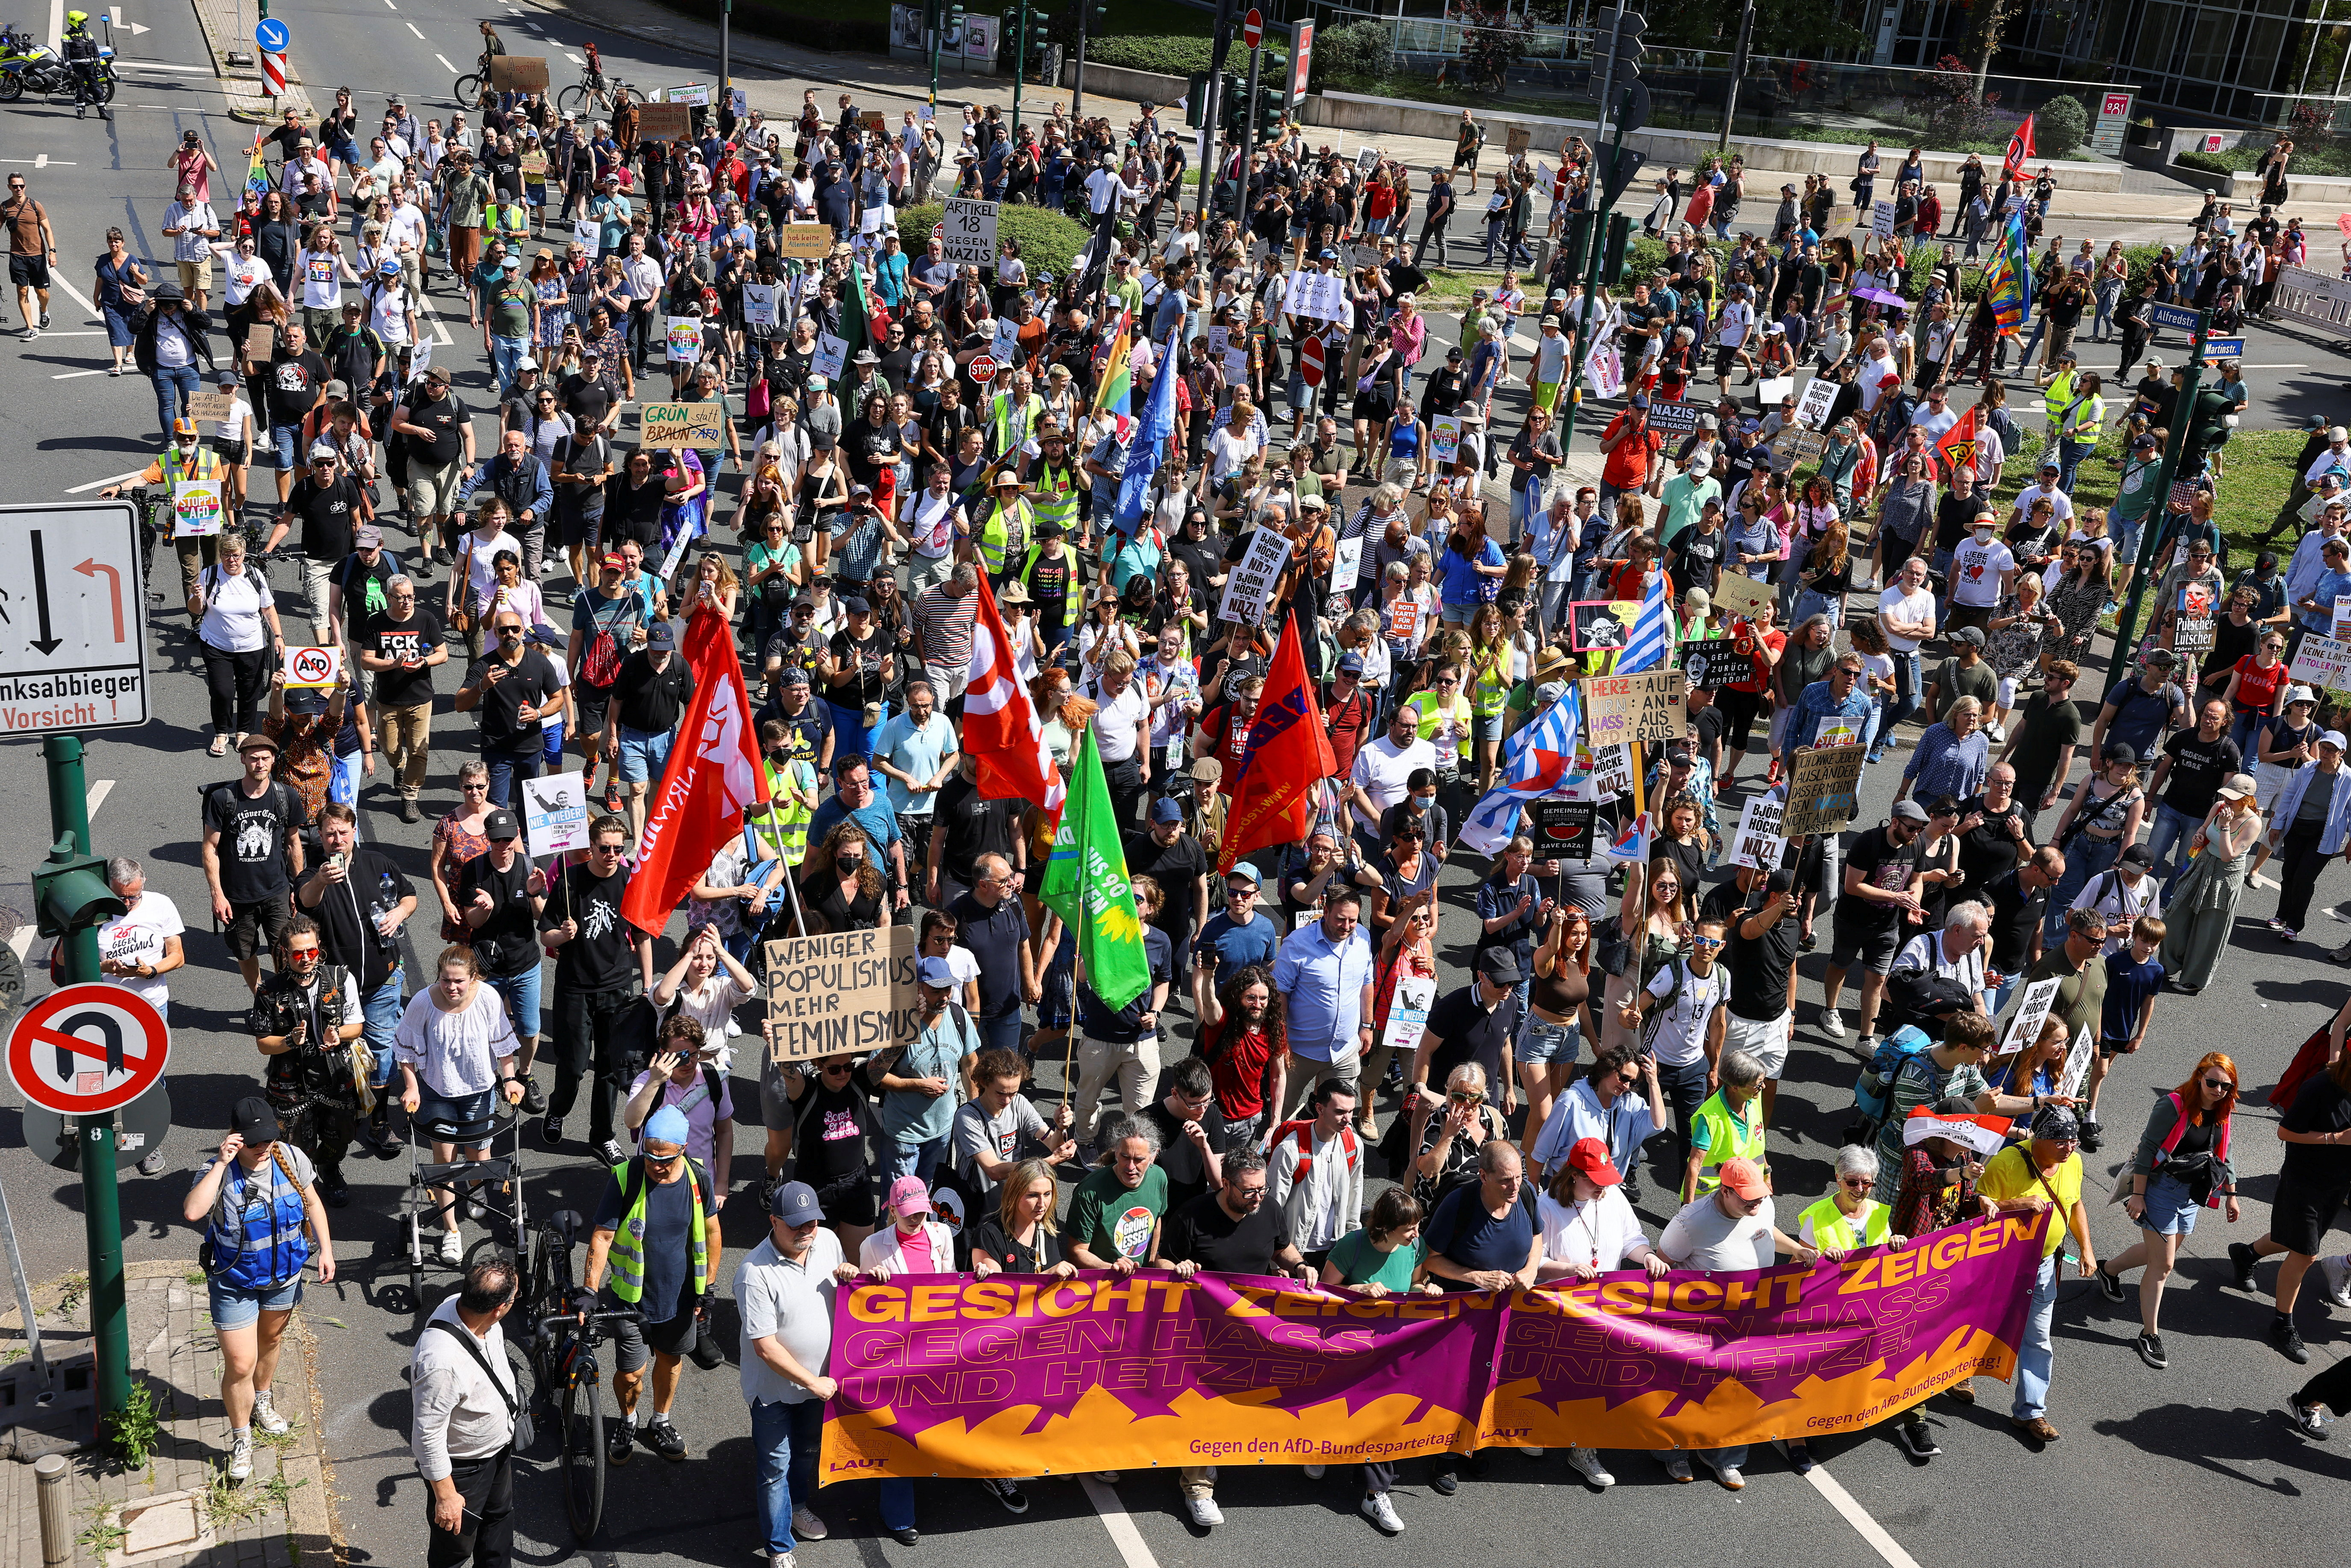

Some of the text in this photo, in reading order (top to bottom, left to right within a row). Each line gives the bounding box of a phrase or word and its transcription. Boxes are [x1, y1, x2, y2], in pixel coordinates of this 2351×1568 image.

[669, 88, 706, 96] MENSCHLICHKEIT
[642, 104, 672, 112] Schmelzt
[856, 118, 885, 132] fck AfD
[944, 200, 996, 218] ARTIKEL
[958, 216, 981, 233] 18
[788, 239, 823, 248] Alternative!
[946, 237, 988, 247] GEGEN
[943, 246, 992, 262] NAZIS
[309, 262, 333, 271] FCK
[310, 270, 333, 280] AFD
[231, 281, 253, 290] RECHTS
[1305, 277, 1327, 288] Gebe
[1294, 284, 1330, 298] Nachhilfe
[1294, 299, 1329, 314] Geschichte
[2157, 309, 2195, 327] Alfredstr.
[671, 329, 695, 338] STOPPT
[677, 338, 692, 348] AFD
[1000, 338, 1013, 348] WIEDER!
[2204, 341, 2237, 354] Martinstr.
[816, 351, 843, 365] NIE WIEDER!
[972, 364, 994, 375] STOP
[1812, 381, 1834, 394] BJÖRN
[1808, 389, 1830, 403] HÖCKE
[645, 404, 718, 424] GRÜN statt
[1651, 403, 1695, 419] NAZIS
[1667, 422, 1692, 431] KACKE
[1734, 458, 1753, 470] PUMA
[180, 495, 215, 507] STOPPT
[189, 506, 209, 519] AFD
[1260, 532, 1285, 551] BJÖRN
[1255, 546, 1280, 563] HÖCKE
[1963, 556, 1987, 565] GEGEN
[1965, 550, 1989, 561] LIEBE
[1342, 560, 1359, 572] WIEDER!
[1235, 572, 1264, 587] BJÖRN
[1232, 583, 1261, 598] HÖCKE
[1227, 598, 1257, 615] NAZI
[1394, 622, 1412, 631] NAZIS
[2176, 616, 2216, 632] Putscher-
[380, 635, 419, 649] FCK
[2174, 631, 2213, 646] Lutscher
[2304, 636, 2341, 651] DIE AFD
[1689, 641, 1721, 651] HÖCKE
[298, 658, 327, 671] AfD
[1711, 663, 1749, 674] ZURÜCK
[2297, 656, 2347, 673] INTOLERANT
[1591, 675, 1681, 697] HERZ AUF
[1709, 674, 1750, 685] MORDOR!
[1591, 694, 1665, 716] HIRN AN
[1590, 710, 1669, 732] HASS AUS
[1590, 727, 1675, 748] AFD RAUS
[1594, 755, 1623, 773] HÖCKE
[2181, 759, 2202, 770] LIBRE
[1790, 793, 1853, 814] DEN NAZIS
[529, 809, 586, 830] NIE WIEDER!
[1741, 837, 1777, 859] NAZI
[105, 934, 154, 959] RASSISMUS
[112, 931, 137, 949] GEGEN
[769, 932, 876, 967] WENIGER
[769, 955, 916, 999] POPULISMUS
[2030, 983, 2054, 1001] BJÖRN
[771, 993, 840, 1020] MEHR
[2024, 997, 2047, 1015] HÖCKE
[825, 1110, 851, 1123] Bored
[1000, 1133, 1016, 1142] FCK
[1001, 1141, 1016, 1152] NZS
[1511, 1213, 2042, 1316] GESICHT ZEIGEN
[846, 1278, 1500, 1323] GESICHT ZEIGEN
[1502, 1275, 1951, 1357] GEGEN HASS
[843, 1319, 1375, 1368] GEGEN HASS
[838, 1356, 1326, 1409] UND HETZE!
[1480, 1428, 1533, 1439] LAUT
[1189, 1430, 1461, 1458] Gegen den AfD-Bundesparteitag!
[830, 1459, 889, 1473] LAUT
